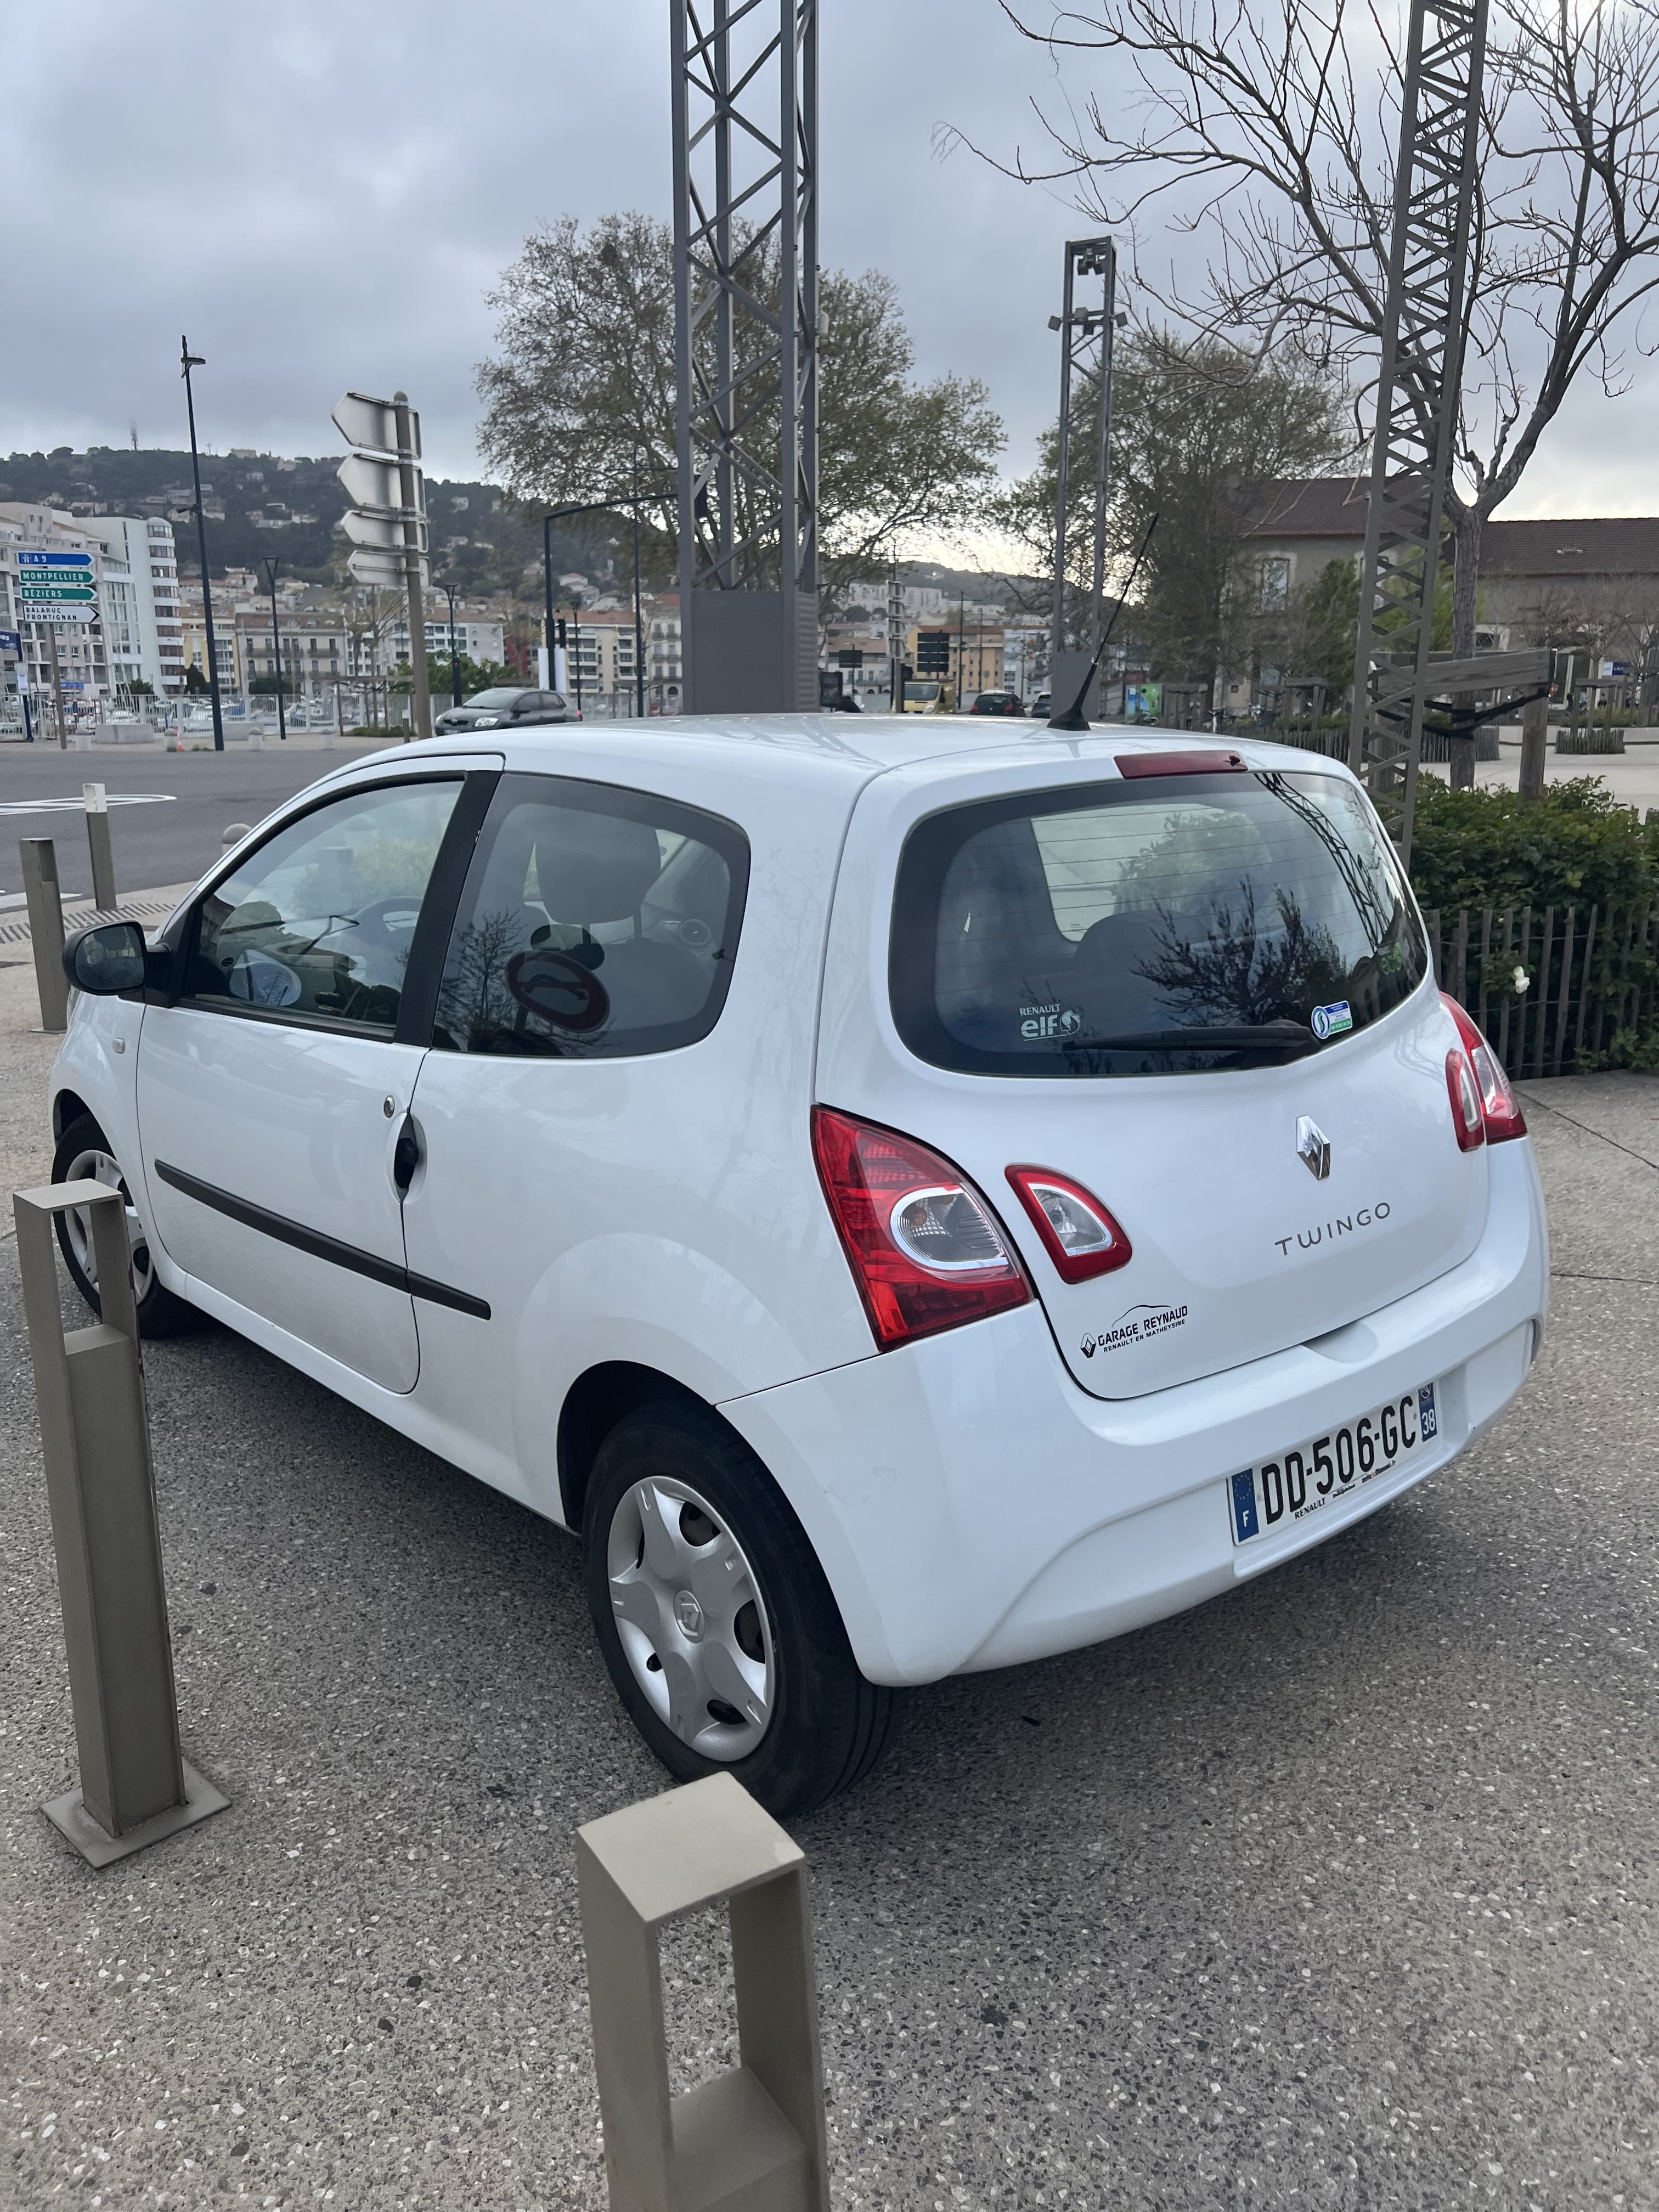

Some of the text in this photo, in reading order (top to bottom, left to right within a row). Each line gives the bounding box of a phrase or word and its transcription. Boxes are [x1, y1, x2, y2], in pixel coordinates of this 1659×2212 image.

[22, 572, 83, 581] MONTPELLIER
[24, 589, 63, 598] BÉZIERS
[1019, 1003, 1060, 1015] RENAULT
[1021, 1014, 1058, 1037] elf
[1274, 1203, 1390, 1256] TWINGO
[1098, 1305, 1188, 1346] GARAGE REYNAUD
[1103, 1338, 1133, 1352] RENAULT
[1146, 1319, 1186, 1338] MATHEYSINE
[1242, 1510, 1250, 1528] F
[1261, 1395, 1416, 1525] DD-506-GC
[1421, 1408, 1436, 1435] 38
[1294, 1497, 1326, 1520] RENAULT
